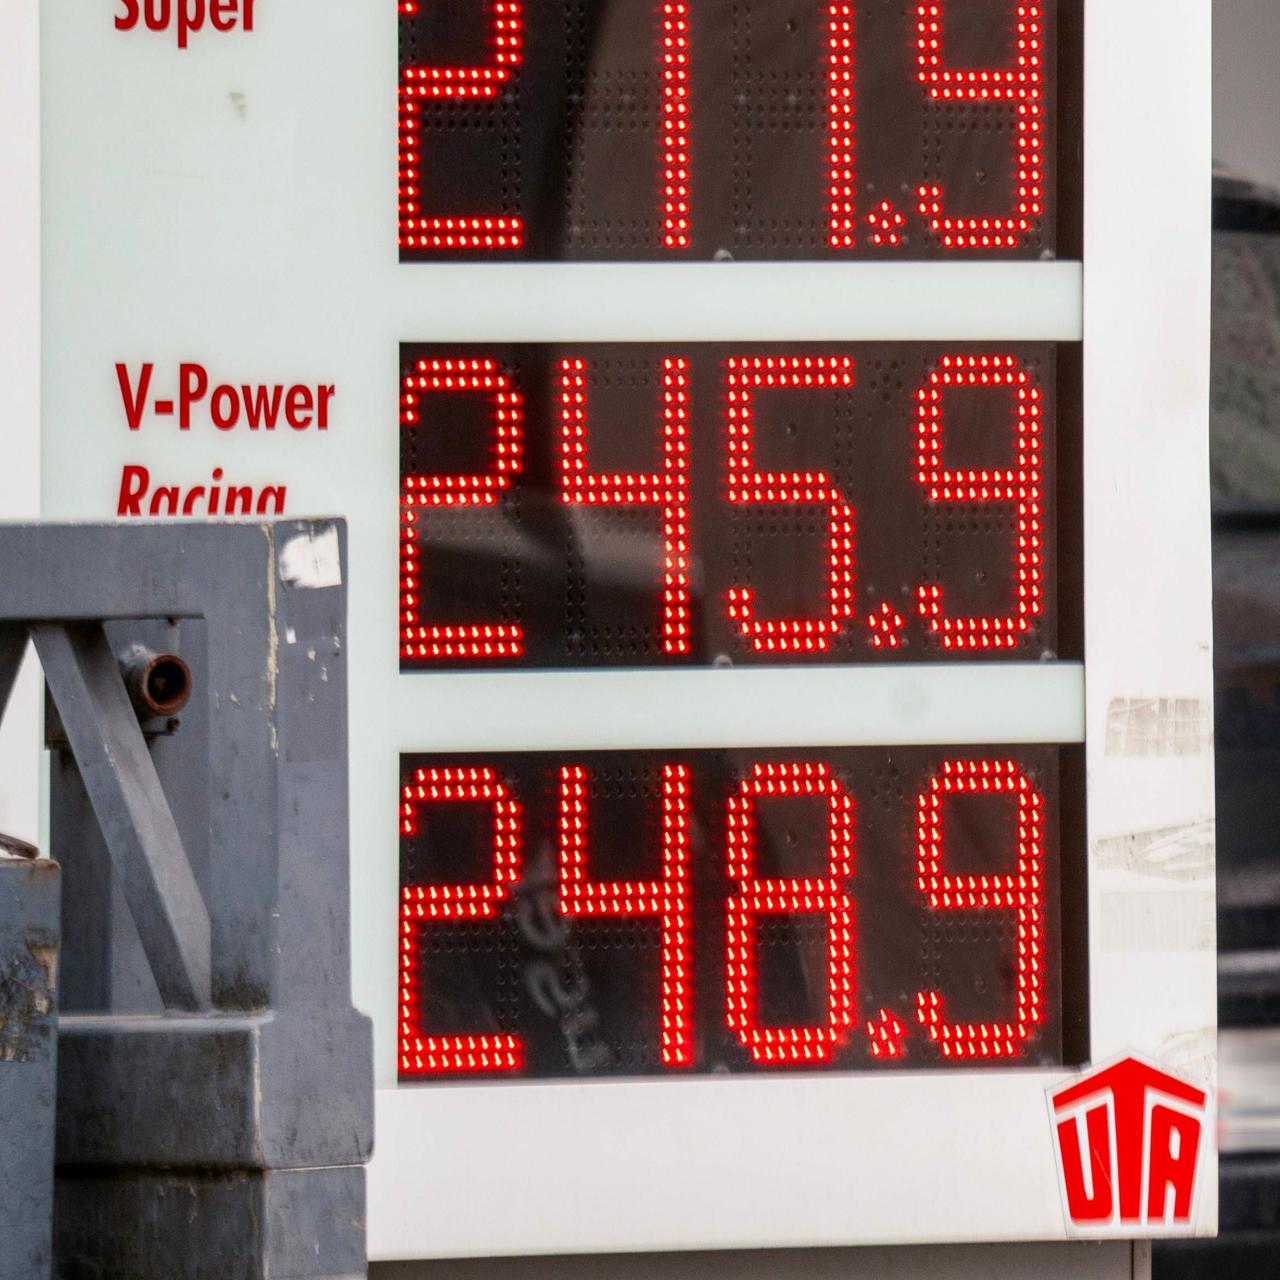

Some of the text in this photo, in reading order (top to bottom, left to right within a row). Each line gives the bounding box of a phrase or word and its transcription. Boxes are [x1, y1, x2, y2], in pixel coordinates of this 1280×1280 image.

[115, 362, 336, 431] V-Power
[399, 353, 1044, 659] 245.9
[399, 765, 1046, 1070] 248.9
[1052, 1056, 1207, 1225] UTA
